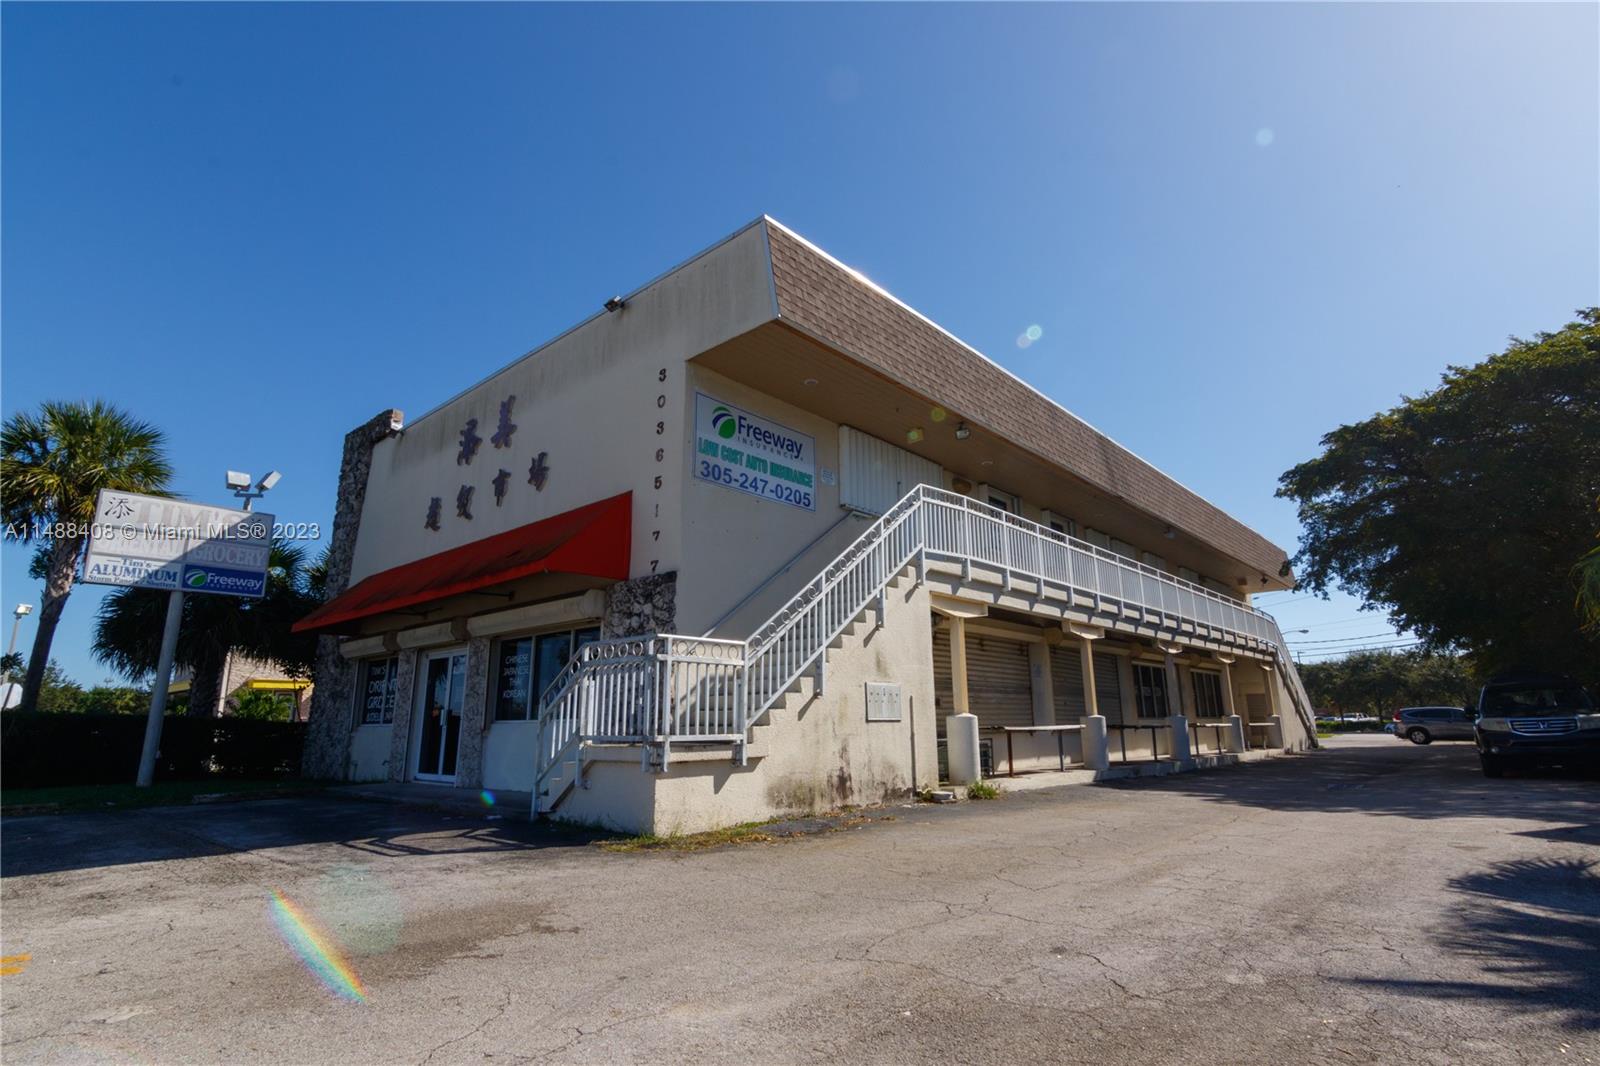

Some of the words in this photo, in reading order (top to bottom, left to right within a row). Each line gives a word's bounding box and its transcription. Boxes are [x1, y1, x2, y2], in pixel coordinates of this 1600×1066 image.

[737, 414, 804, 459] Freeway
[737, 436, 795, 461] INSURANCE
[720, 444, 744, 467] COST
[745, 453, 768, 475] AUTO
[700, 459, 812, 508] 305-247-0205
[122, 556, 152, 568] Tim's
[192, 542, 265, 567] GROCERY
[90, 563, 178, 583] ALUMINUM
[207, 572, 263, 590] Freeway
